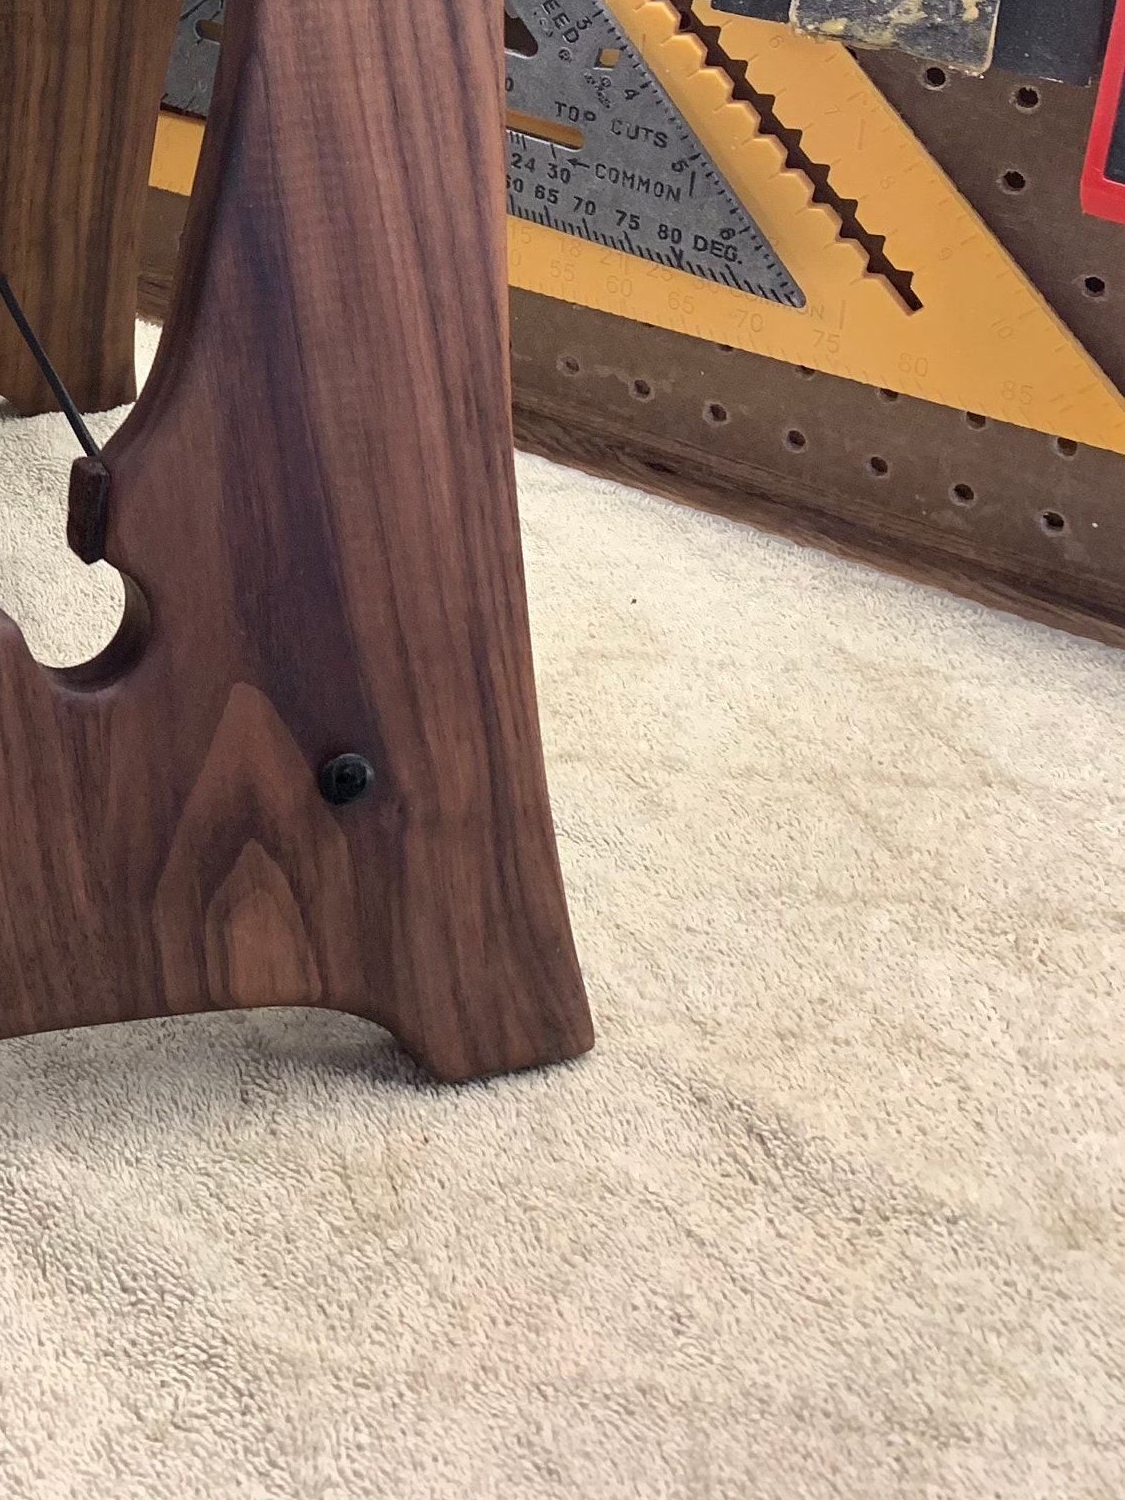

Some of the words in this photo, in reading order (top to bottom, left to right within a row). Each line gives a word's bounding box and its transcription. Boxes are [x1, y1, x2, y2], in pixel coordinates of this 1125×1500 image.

[555, 100, 597, 123] TOP
[611, 118, 669, 149] CUTS
[576, 16, 594, 31] 3
[624, 88, 639, 101] 4
[671, 159, 689, 174] 5
[719, 227, 737, 241] 6
[511, 152, 536, 173] 24
[547, 162, 571, 184] 30
[595, 162, 682, 203] COMMON
[534, 185, 560, 205] 65
[573, 195, 597, 216] 70
[615, 209, 641, 232] 75
[657, 224, 683, 245] 80
[692, 235, 743, 265] DEG.
[549, 260, 576, 282] 55
[606, 274, 633, 298] 60
[667, 291, 696, 316] 65
[736, 308, 765, 333] 70
[812, 329, 841, 355] 75
[896, 352, 929, 378] 80
[1001, 380, 1034, 405] 85
